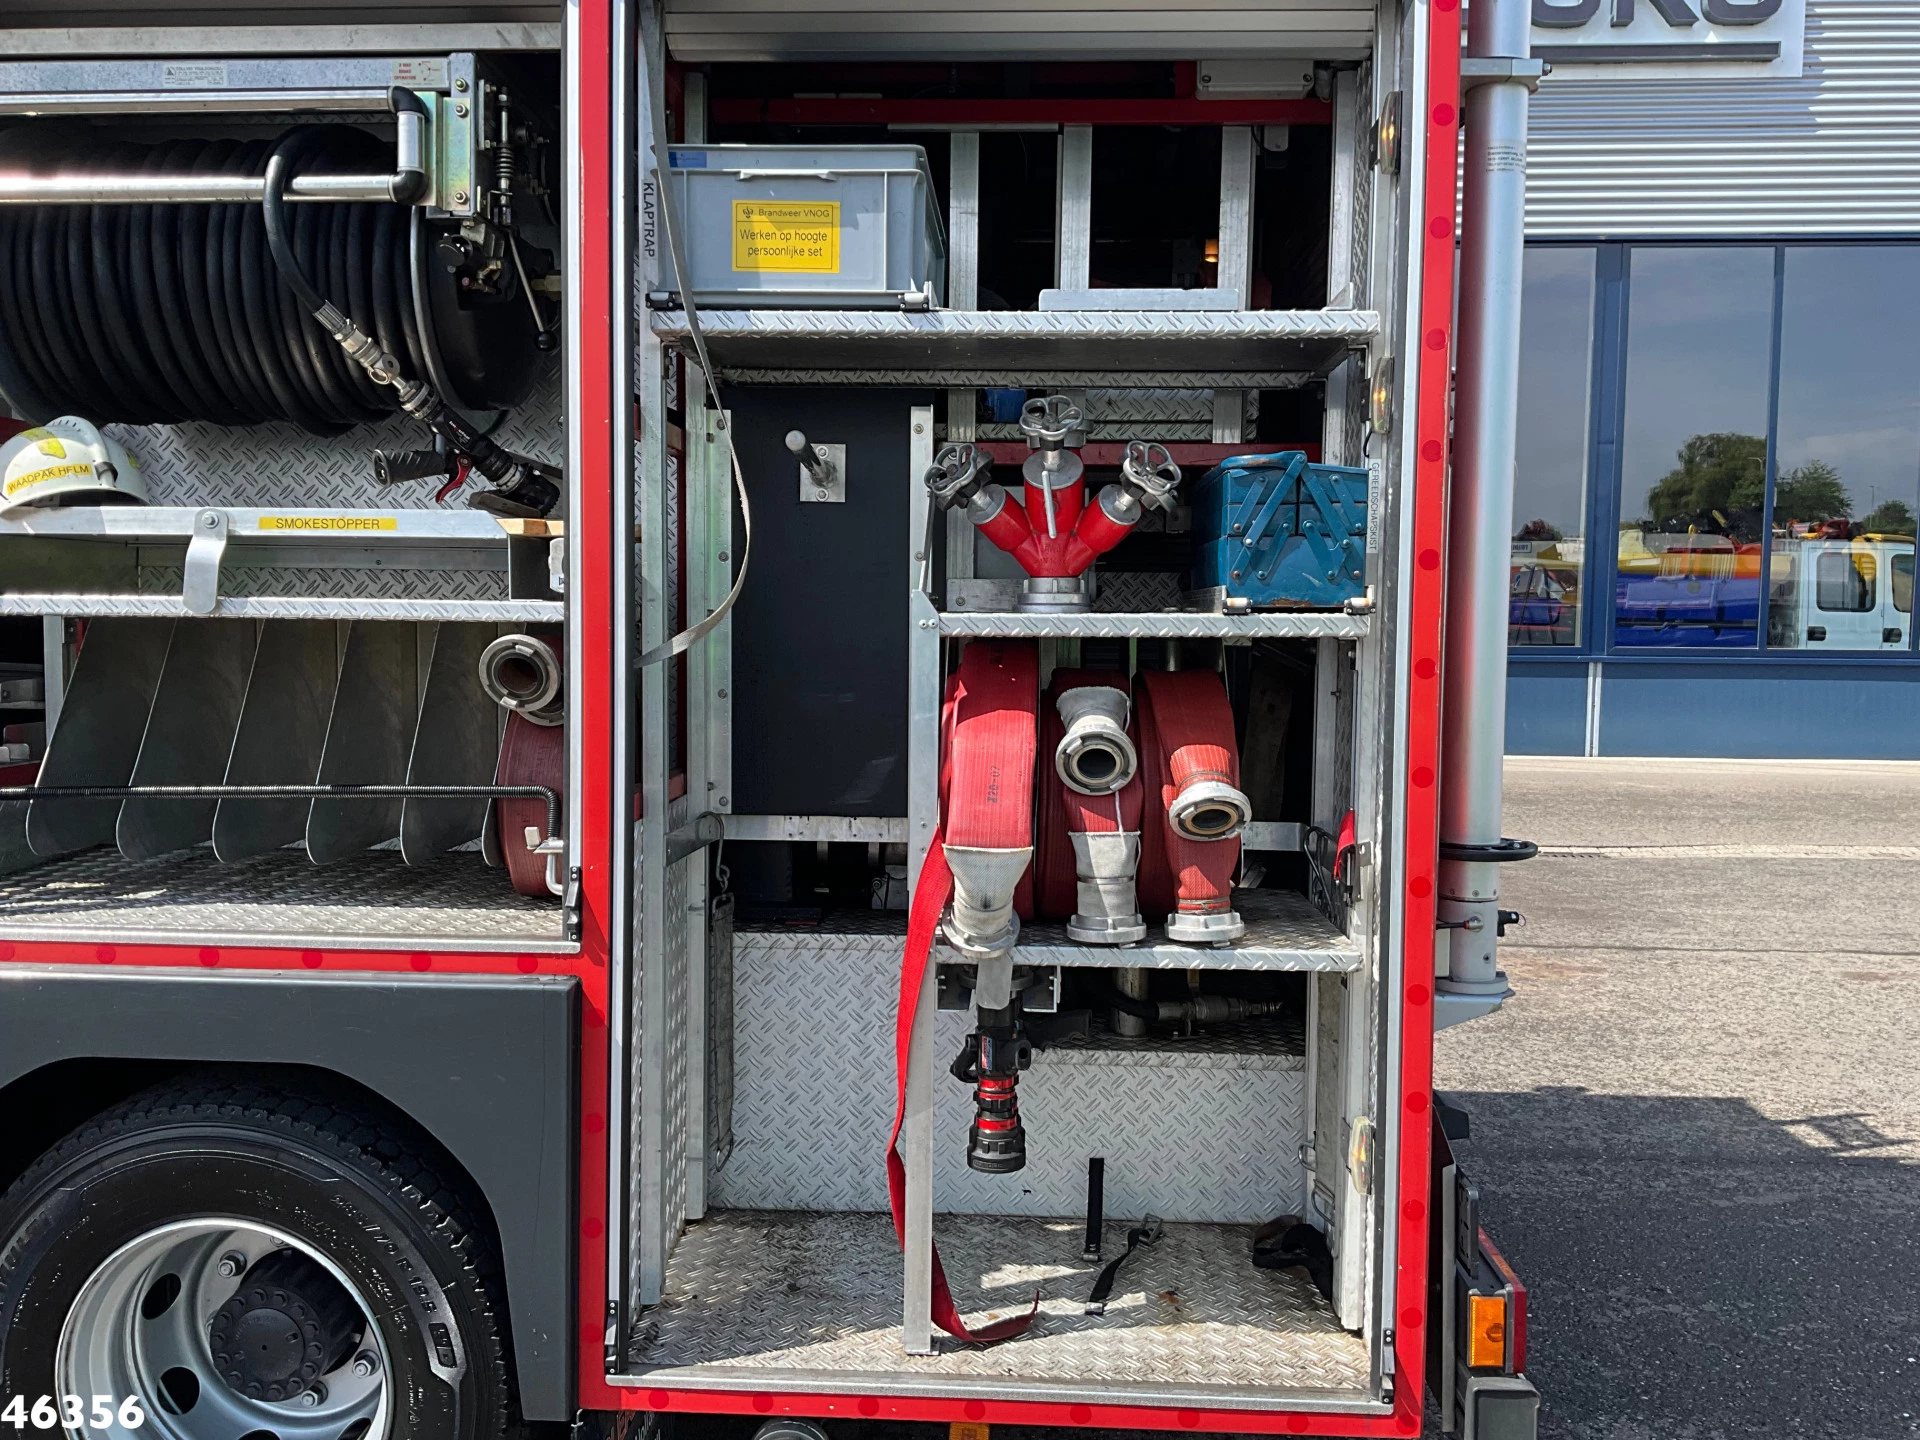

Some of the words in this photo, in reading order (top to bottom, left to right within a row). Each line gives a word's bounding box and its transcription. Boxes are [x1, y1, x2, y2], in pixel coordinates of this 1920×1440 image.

[643, 182, 655, 257] KLAPTRAP
[758, 208, 801, 217] Brandweer
[804, 209, 830, 218] VNOG
[740, 229, 777, 240] Werken
[779, 231, 792, 242] op
[794, 230, 828, 243] hoogte
[747, 246, 805, 259] persoonlijke
[807, 246, 823, 257] set
[9, 468, 55, 492] WAADPAK
[1369, 462, 1379, 550] GEREEDSCHAPSKIST
[276, 518, 380, 529] SMOKESTOPPER
